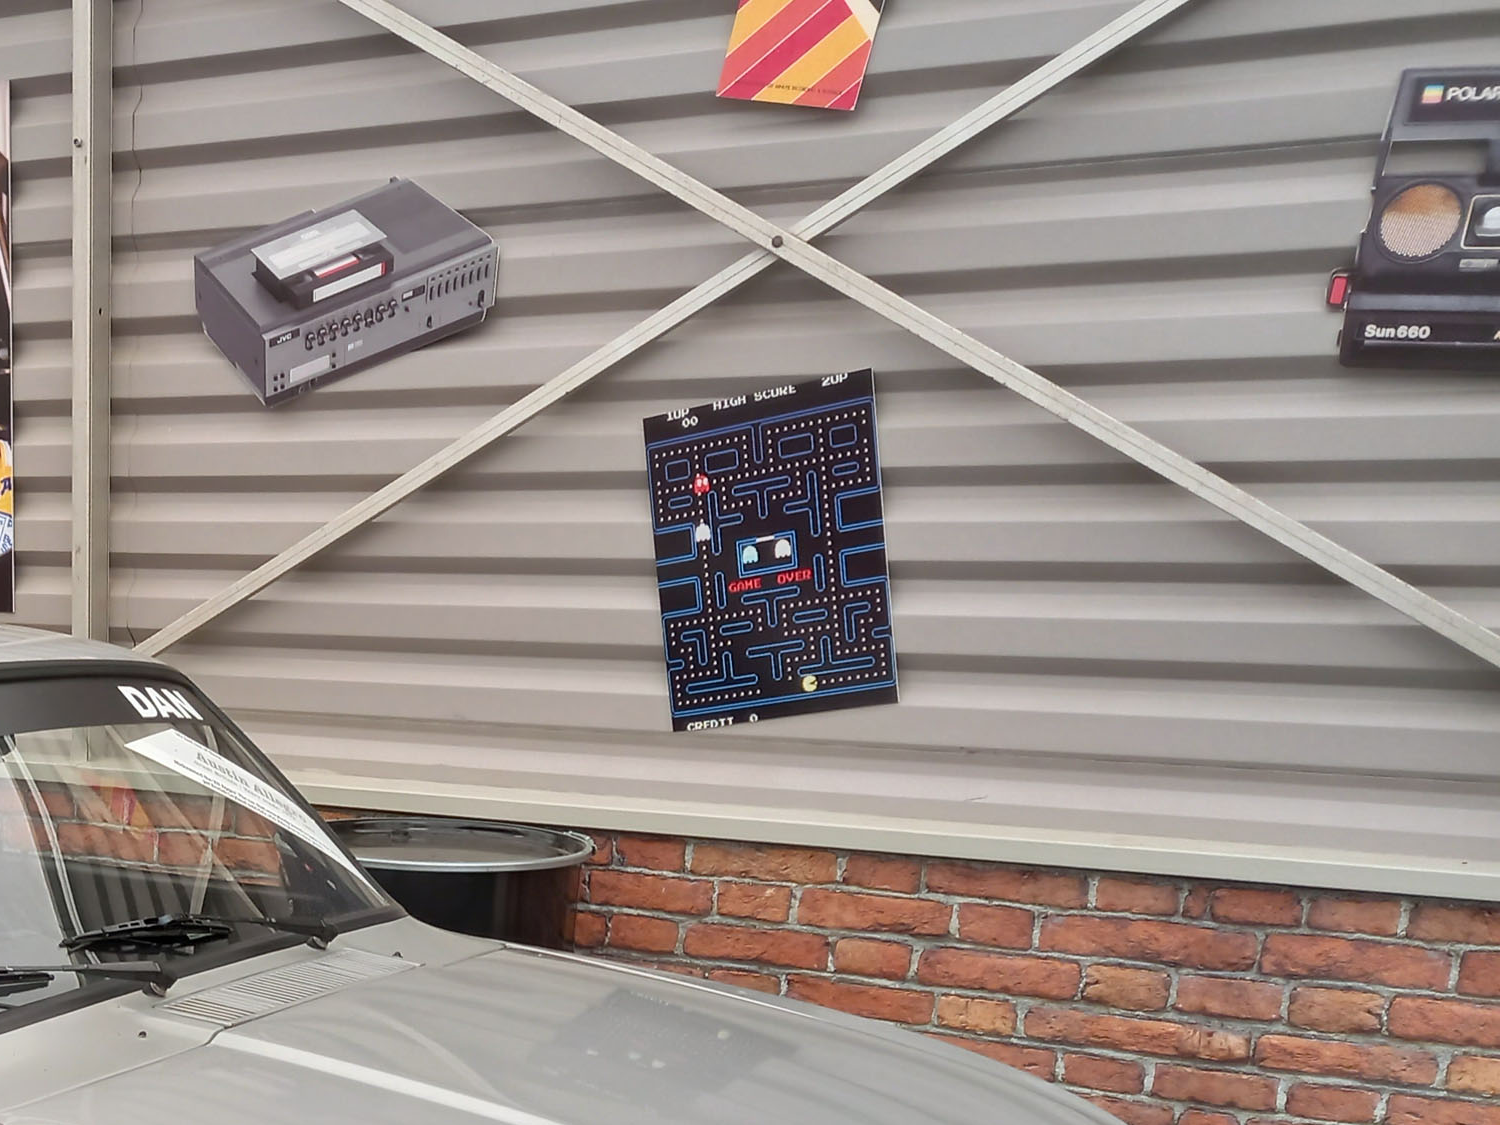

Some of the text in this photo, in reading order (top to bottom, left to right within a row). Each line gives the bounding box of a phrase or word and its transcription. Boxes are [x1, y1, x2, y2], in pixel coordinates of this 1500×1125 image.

[665, 372, 848, 422] 1UP HIGH SCORE 2UP
[681, 415, 699, 429] 00
[728, 569, 812, 593] GAME OVER
[118, 685, 204, 721] DAN
[686, 716, 735, 732] CREDIT
